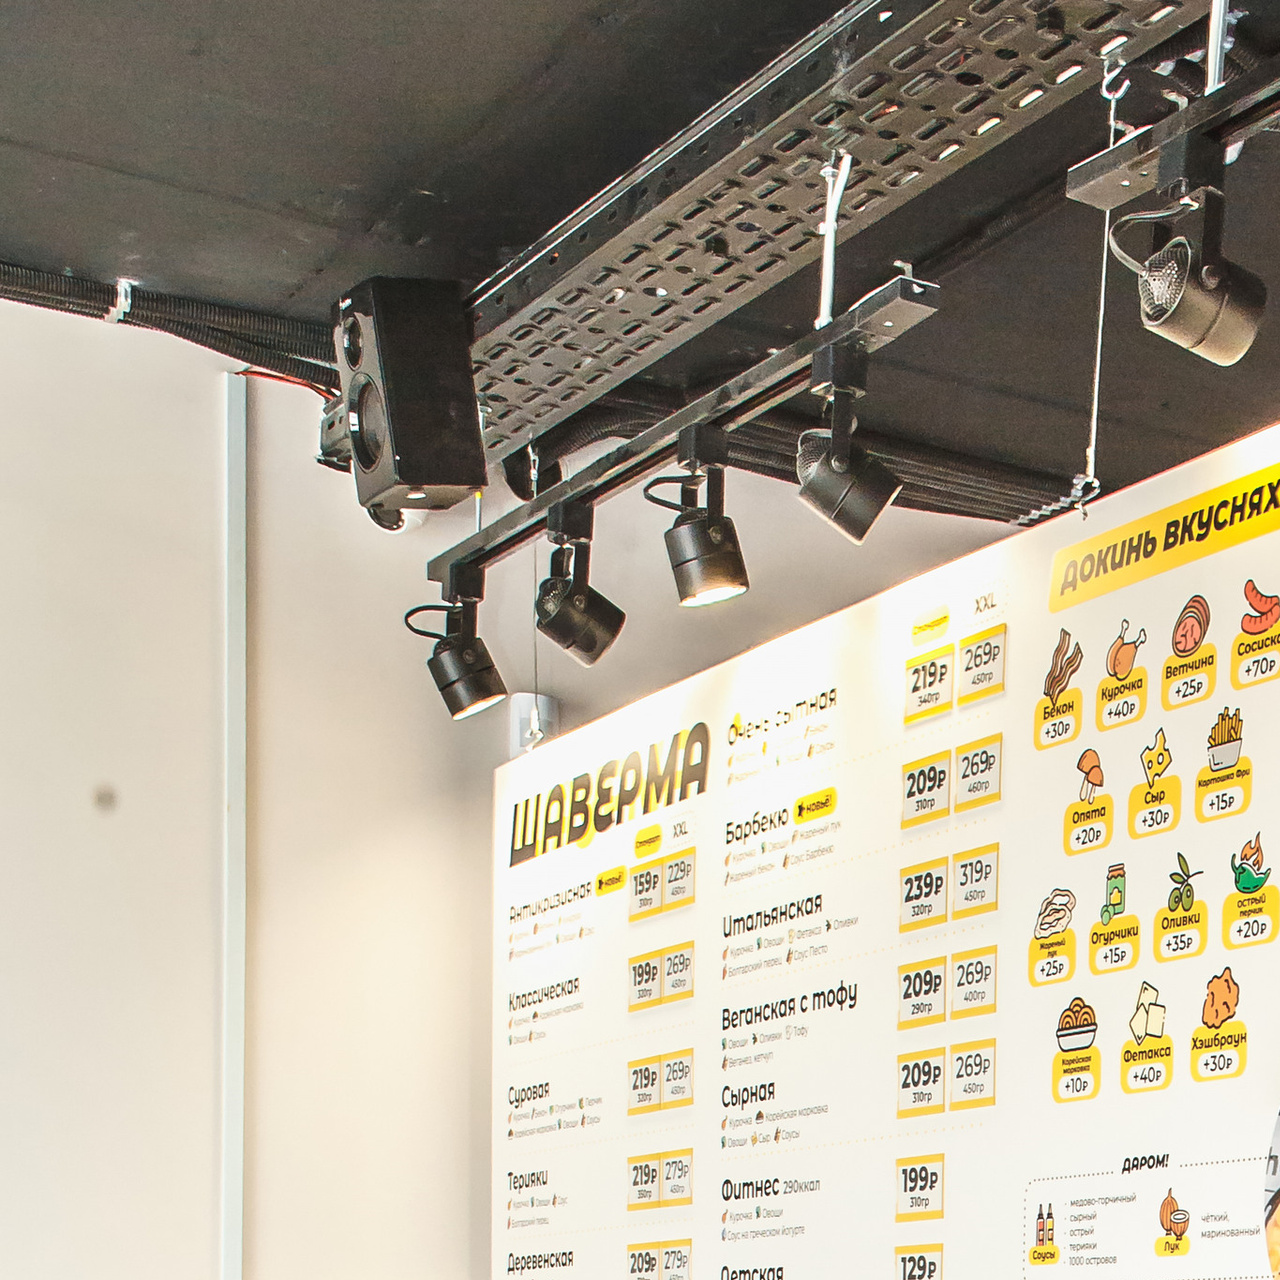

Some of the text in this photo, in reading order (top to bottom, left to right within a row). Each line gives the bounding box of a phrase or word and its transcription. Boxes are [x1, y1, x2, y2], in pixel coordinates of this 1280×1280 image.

[1060, 530, 1157, 596] ДОКИНЬ
[1165, 655, 1214, 679] Ветчина
[1101, 678, 1143, 701] Курочка
[1043, 701, 1074, 721] Бекон
[1199, 768, 1250, 788] Картошка Фри
[510, 722, 711, 867] ШАВЕРМА
[1144, 791, 1165, 806] Сыр
[1072, 805, 1106, 824] Опята
[726, 808, 788, 846] Барбекю
[723, 894, 822, 938] Итальянская
[1161, 913, 1200, 931] Оливки
[1091, 925, 1139, 945] Огурчики
[509, 977, 580, 1012] Классическая
[722, 980, 858, 1030] Веганская с тофу
[1192, 1032, 1247, 1051] Хэшбраун
[1123, 1045, 1171, 1064] Фетакса
[508, 1082, 550, 1109] Суровая
[722, 1082, 776, 1110] Сырная
[1121, 1154, 1169, 1174] ДАРОМ!
[508, 1170, 548, 1194] Терияки
[722, 1178, 780, 1202] Фитнес
[1033, 1250, 1056, 1261] Соусы
[1164, 1241, 1179, 1252] Лук
[507, 1251, 574, 1276] Деревенская
